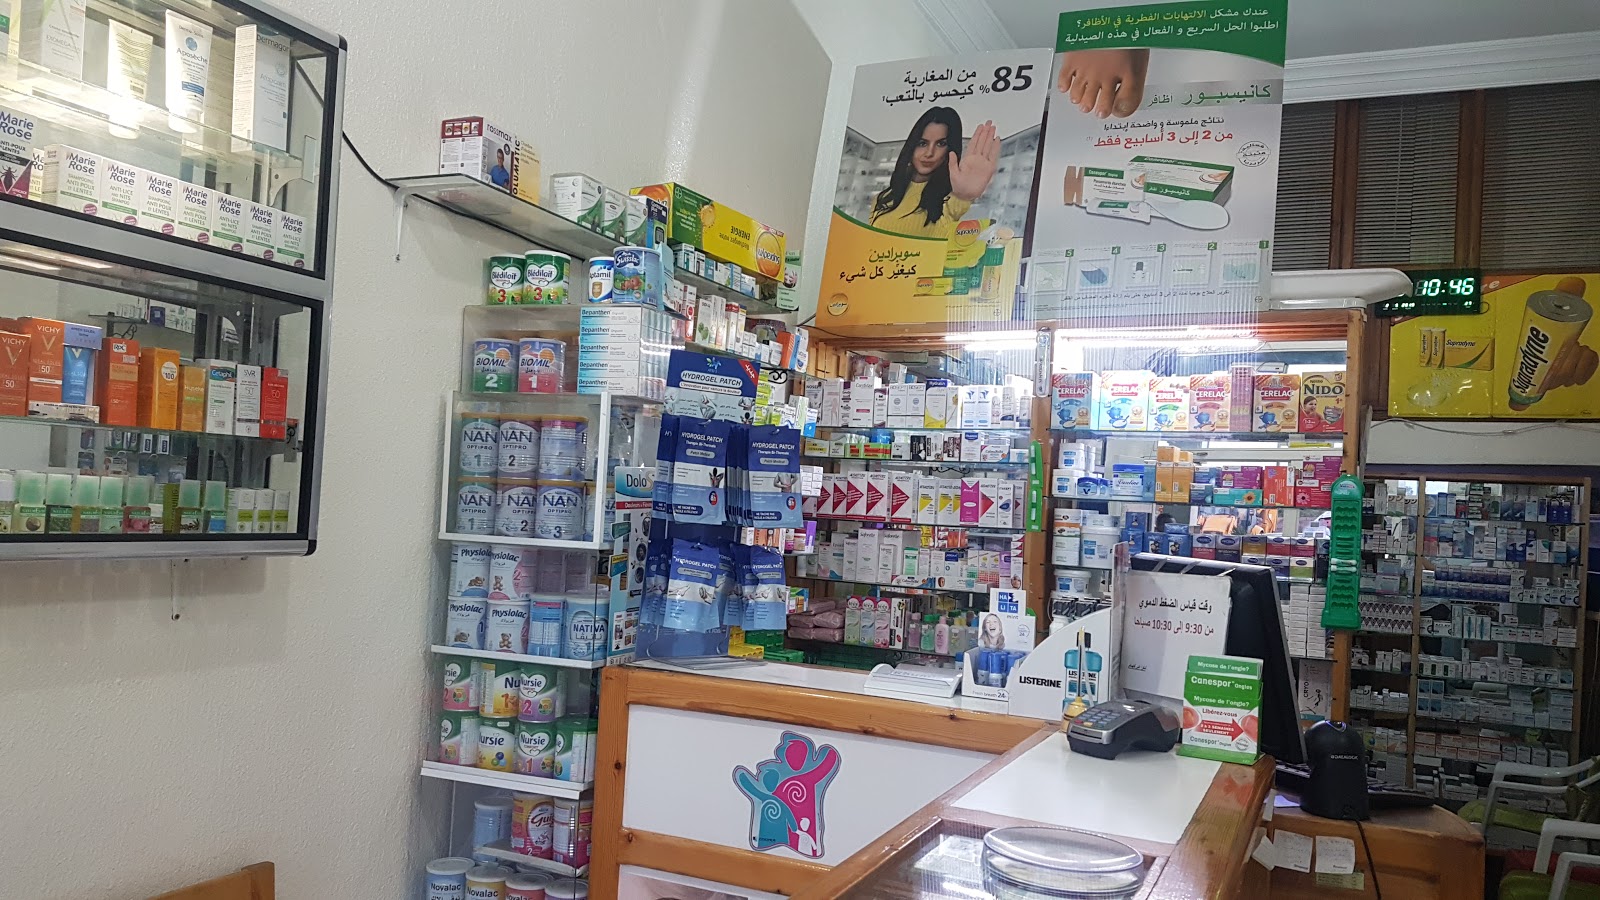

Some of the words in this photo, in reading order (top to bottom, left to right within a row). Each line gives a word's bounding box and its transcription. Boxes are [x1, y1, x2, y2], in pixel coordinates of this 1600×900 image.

[1210, 9, 1239, 19] مشكل
[1243, 8, 1268, 17] عندك
[1113, 16, 1122, 26] في
[1126, 13, 1160, 25] الفطرية
[1143, 26, 1174, 37] الفعال
[1186, 24, 1220, 36] السريع
[1223, 21, 1246, 32] الحل
[1065, 32, 1104, 44] الصيدلية
[1108, 30, 1128, 40] هذه
[904, 68, 952, 86] المغاربة
[957, 70, 976, 80] من
[928, 84, 974, 102] كيحسو
[1182, 84, 1271, 105] كانيسبور
[0, 111, 34, 130] Marie
[0, 121, 32, 140] Rose
[486, 123, 512, 143] rossmax
[1202, 130, 1211, 140] 2
[1168, 132, 1176, 142] 3
[70, 152, 96, 166] Marie
[68, 160, 95, 175] Rose
[110, 164, 136, 178] Marie
[512, 139, 520, 195] OLUMATIC
[110, 172, 135, 186] Rose
[148, 176, 173, 188] Marie
[73, 187, 93, 196] LENTES
[148, 183, 172, 196] Rose
[185, 186, 208, 200] Marie
[184, 194, 207, 207] Rose
[220, 196, 242, 209] Marie
[220, 204, 241, 216] Rose
[253, 206, 273, 218] Marie
[252, 213, 272, 225] Rose
[283, 216, 303, 227] Marie
[283, 223, 302, 234] Rose
[730, 225, 750, 240] ENERGIE
[492, 271, 517, 280] Blédilait
[528, 269, 553, 278] Blédilait
[839, 270, 866, 284] شيء
[870, 266, 884, 280] كل
[1422, 278, 1474, 296] 10:46
[498, 288, 506, 302] 3
[534, 287, 542, 300] 3
[37, 324, 60, 334] VICHY
[581, 326, 610, 334] Bepanthen
[2, 337, 26, 346] VICHY
[1446, 339, 1476, 348] Supradyne
[476, 358, 506, 367] BIOMIL
[520, 358, 550, 368] BIOMIL
[1512, 326, 1550, 394] Supradyne
[211, 369, 232, 378] Cetaphil
[682, 372, 717, 383] HYDROGEL
[720, 378, 742, 386] PATCH
[485, 374, 498, 388] 2
[528, 374, 538, 388] 1
[1194, 390, 1228, 398] CERELAC
[1260, 390, 1293, 398] CERELAC
[1304, 384, 1344, 395] NIDO
[463, 430, 498, 444] NAN
[500, 430, 532, 442] NAN
[682, 432, 706, 441] HYDROGEL
[752, 442, 778, 450] HYDROGEL
[474, 454, 482, 466] 1
[508, 454, 516, 466] 2
[459, 494, 492, 507] NAN
[543, 495, 578, 507] NAN
[468, 518, 474, 530] 1
[520, 520, 528, 532] 2
[554, 526, 562, 538] 3
[674, 556, 701, 566] HYDROGEL
[514, 570, 522, 580] 2
[1138, 598, 1158, 609] الدموي
[1159, 597, 1178, 608] الضغط
[1180, 598, 1196, 612] قياس
[1198, 600, 1212, 614] وقت
[450, 604, 484, 614] Physiolac
[492, 608, 527, 618] Physiolac
[478, 622, 484, 632] 1
[573, 624, 604, 632] NATIVA
[1134, 616, 1151, 628] صباحا
[1152, 619, 1172, 630] 10:30
[1186, 622, 1202, 634] 9:30
[521, 626, 528, 638] 2
[1204, 626, 1214, 636] من
[1228, 664, 1250, 672] l'ongle?
[1019, 676, 1062, 688] LISTERINE
[1190, 676, 1232, 688] Canespor
[523, 700, 532, 714] 2
[1194, 696, 1216, 704] Mycose
[1226, 700, 1250, 708] l'ongle?
[1202, 708, 1238, 717] Libérez-vous
[520, 734, 546, 746] Nursie
[1190, 736, 1217, 744] Canespor
[526, 758, 533, 773] 1
[527, 848, 532, 856] 2
[430, 882, 462, 892] Novalac
[466, 886, 498, 898] Novalac
